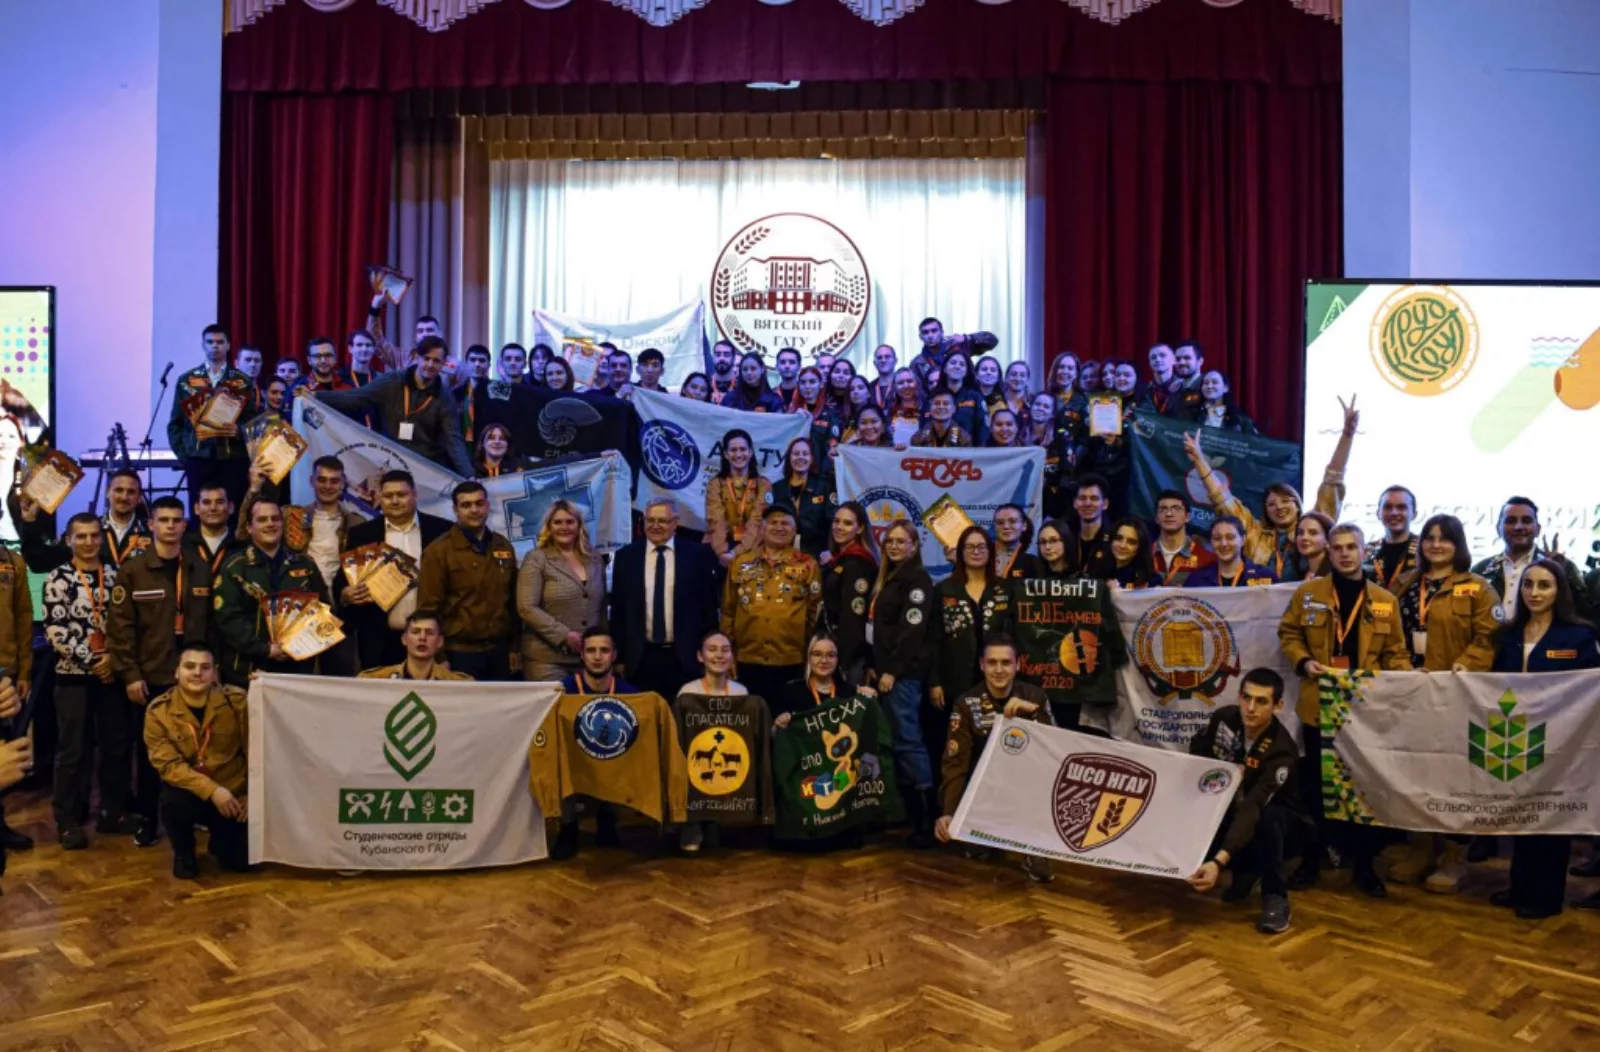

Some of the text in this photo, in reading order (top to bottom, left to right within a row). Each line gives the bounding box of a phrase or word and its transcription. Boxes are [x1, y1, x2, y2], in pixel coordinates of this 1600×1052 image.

[753, 319, 823, 331] ВЯТСКИЙ
[773, 335, 808, 347] ГАТУ
[707, 440, 787, 468] АТУ
[1042, 676, 1073, 689] 2020
[708, 698, 732, 711] СВО
[685, 712, 750, 728] СПАСАТЕЛИ
[804, 698, 867, 733] НГСХА
[1141, 708, 1213, 720] СТАВРОПОЛЬ
[801, 752, 823, 770] СПО
[1066, 762, 1103, 786] ШСО
[1107, 769, 1149, 794] НГАУ
[857, 779, 885, 796] 2020
[1472, 814, 1540, 828] АКАДЕМИЯ
[343, 829, 467, 844] Студенческие отряды
[360, 843, 449, 857] Кубанского ГАУ
